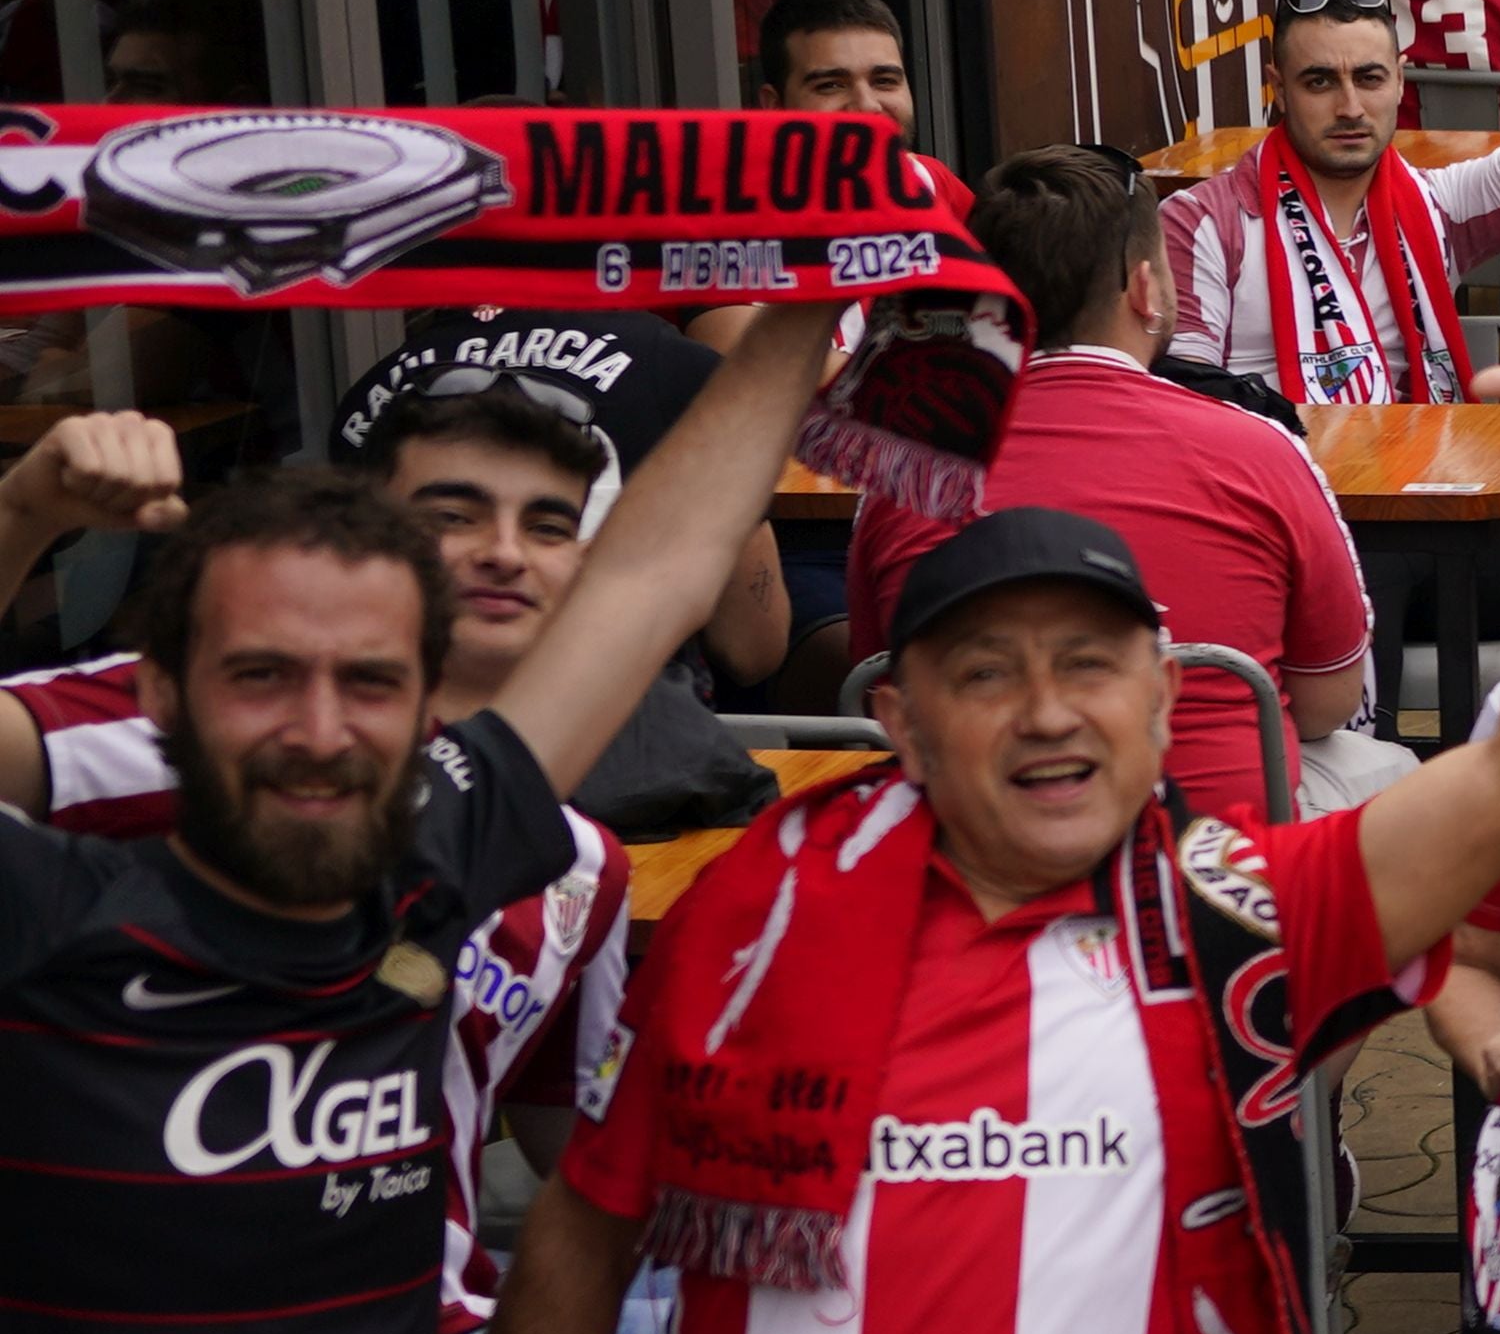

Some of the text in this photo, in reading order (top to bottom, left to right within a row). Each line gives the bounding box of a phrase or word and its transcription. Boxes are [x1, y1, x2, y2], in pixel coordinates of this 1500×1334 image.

[596, 234, 939, 293] 6 ABRIL 2024
[455, 328, 632, 393] GARCÍA
[320, 1162, 431, 1218] by Taica
